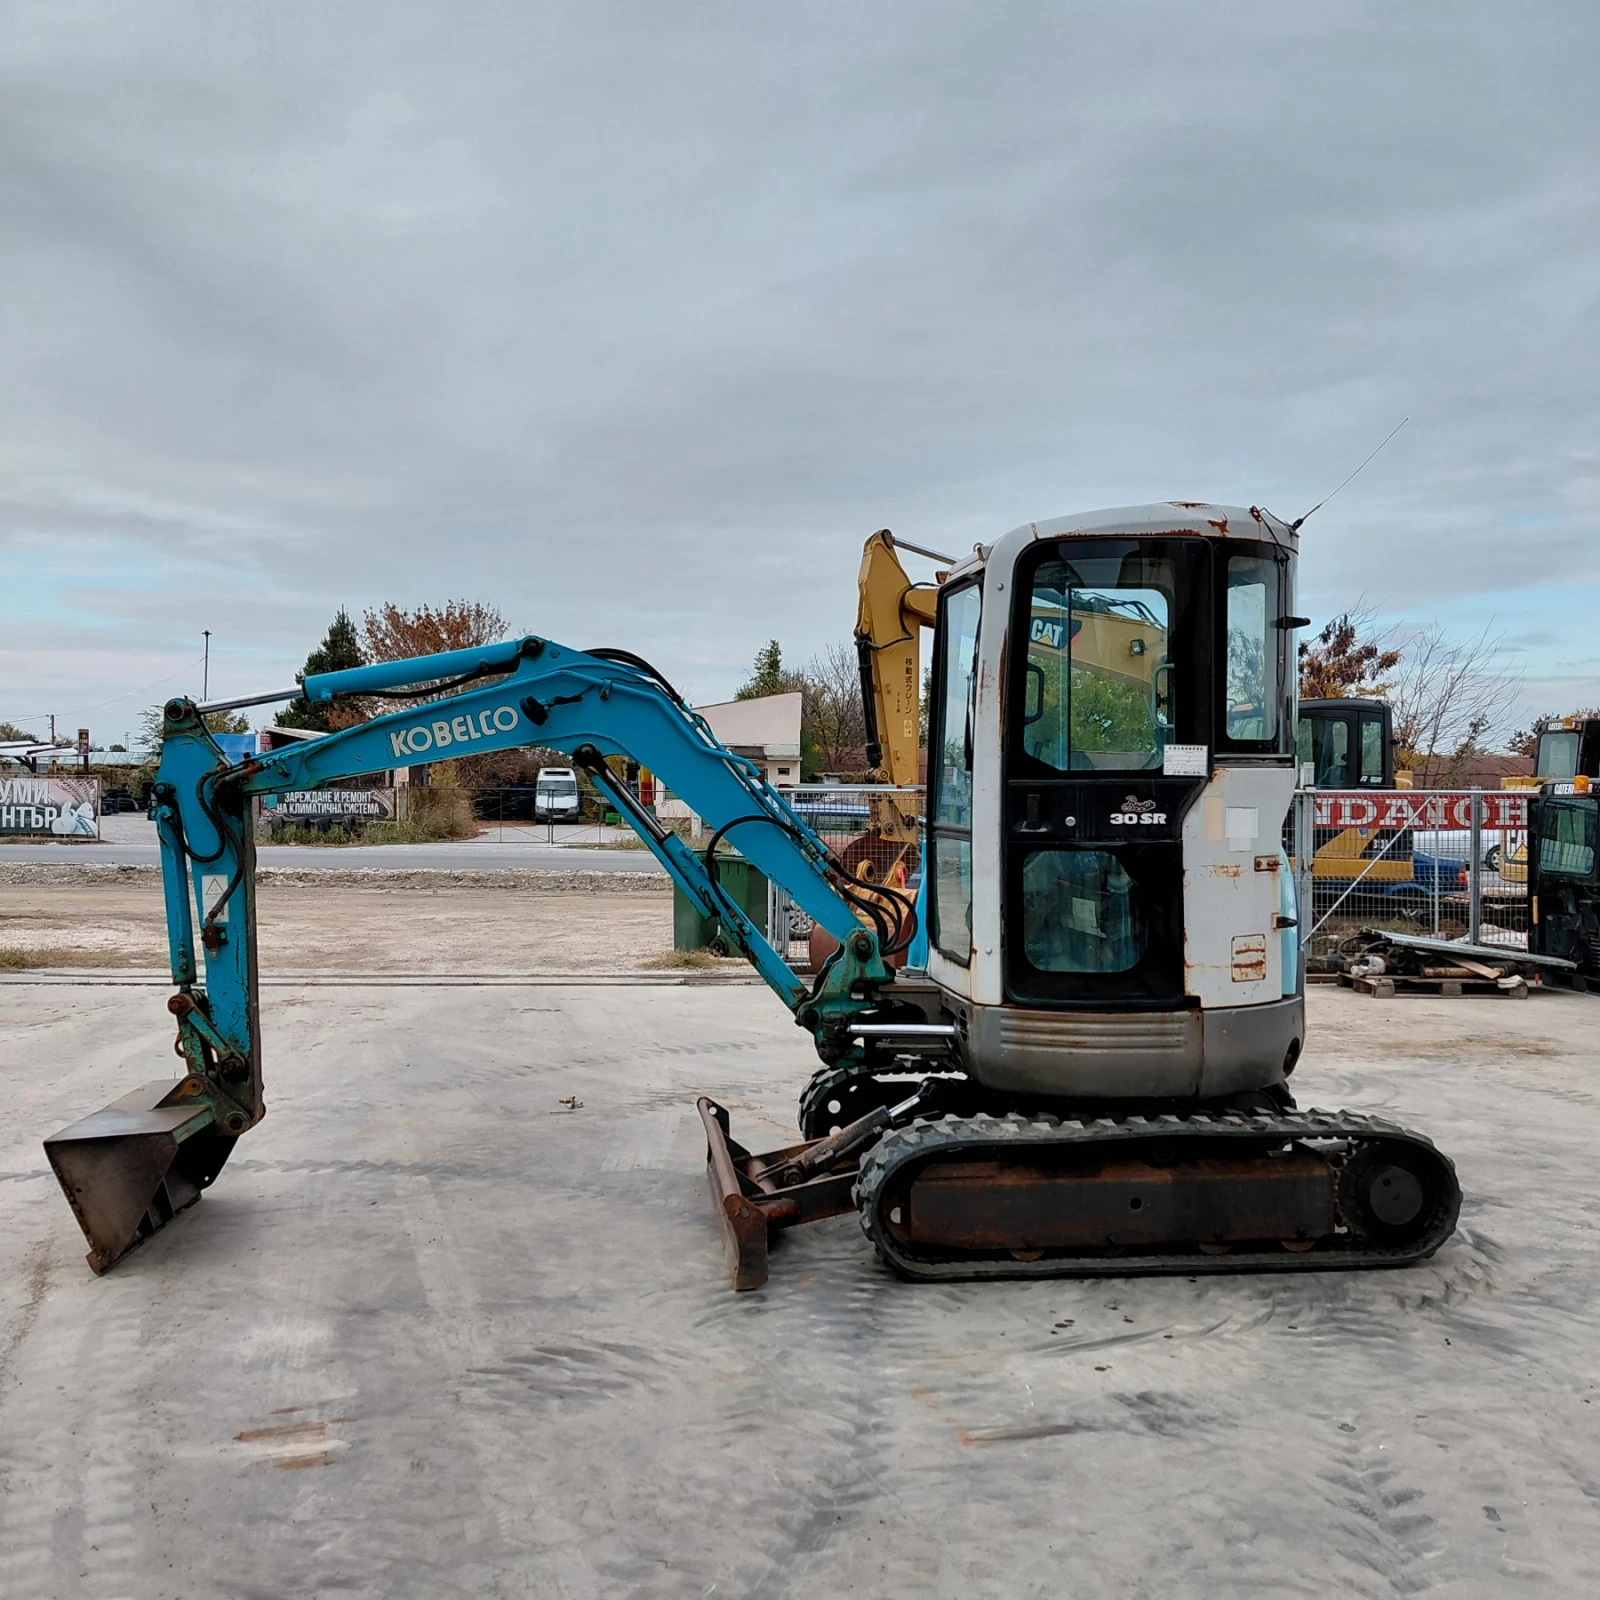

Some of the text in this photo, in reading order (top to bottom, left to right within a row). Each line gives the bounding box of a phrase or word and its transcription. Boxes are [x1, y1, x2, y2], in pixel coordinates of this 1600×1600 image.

[1031, 619, 1064, 648] CAT
[389, 706, 519, 758] KOBELCO
[284, 791, 372, 804] ЗАРЕЖДАНЕ И РЕМОНТ
[277, 803, 380, 814] НА КЛИМАТИЧНА СИСТЕМА
